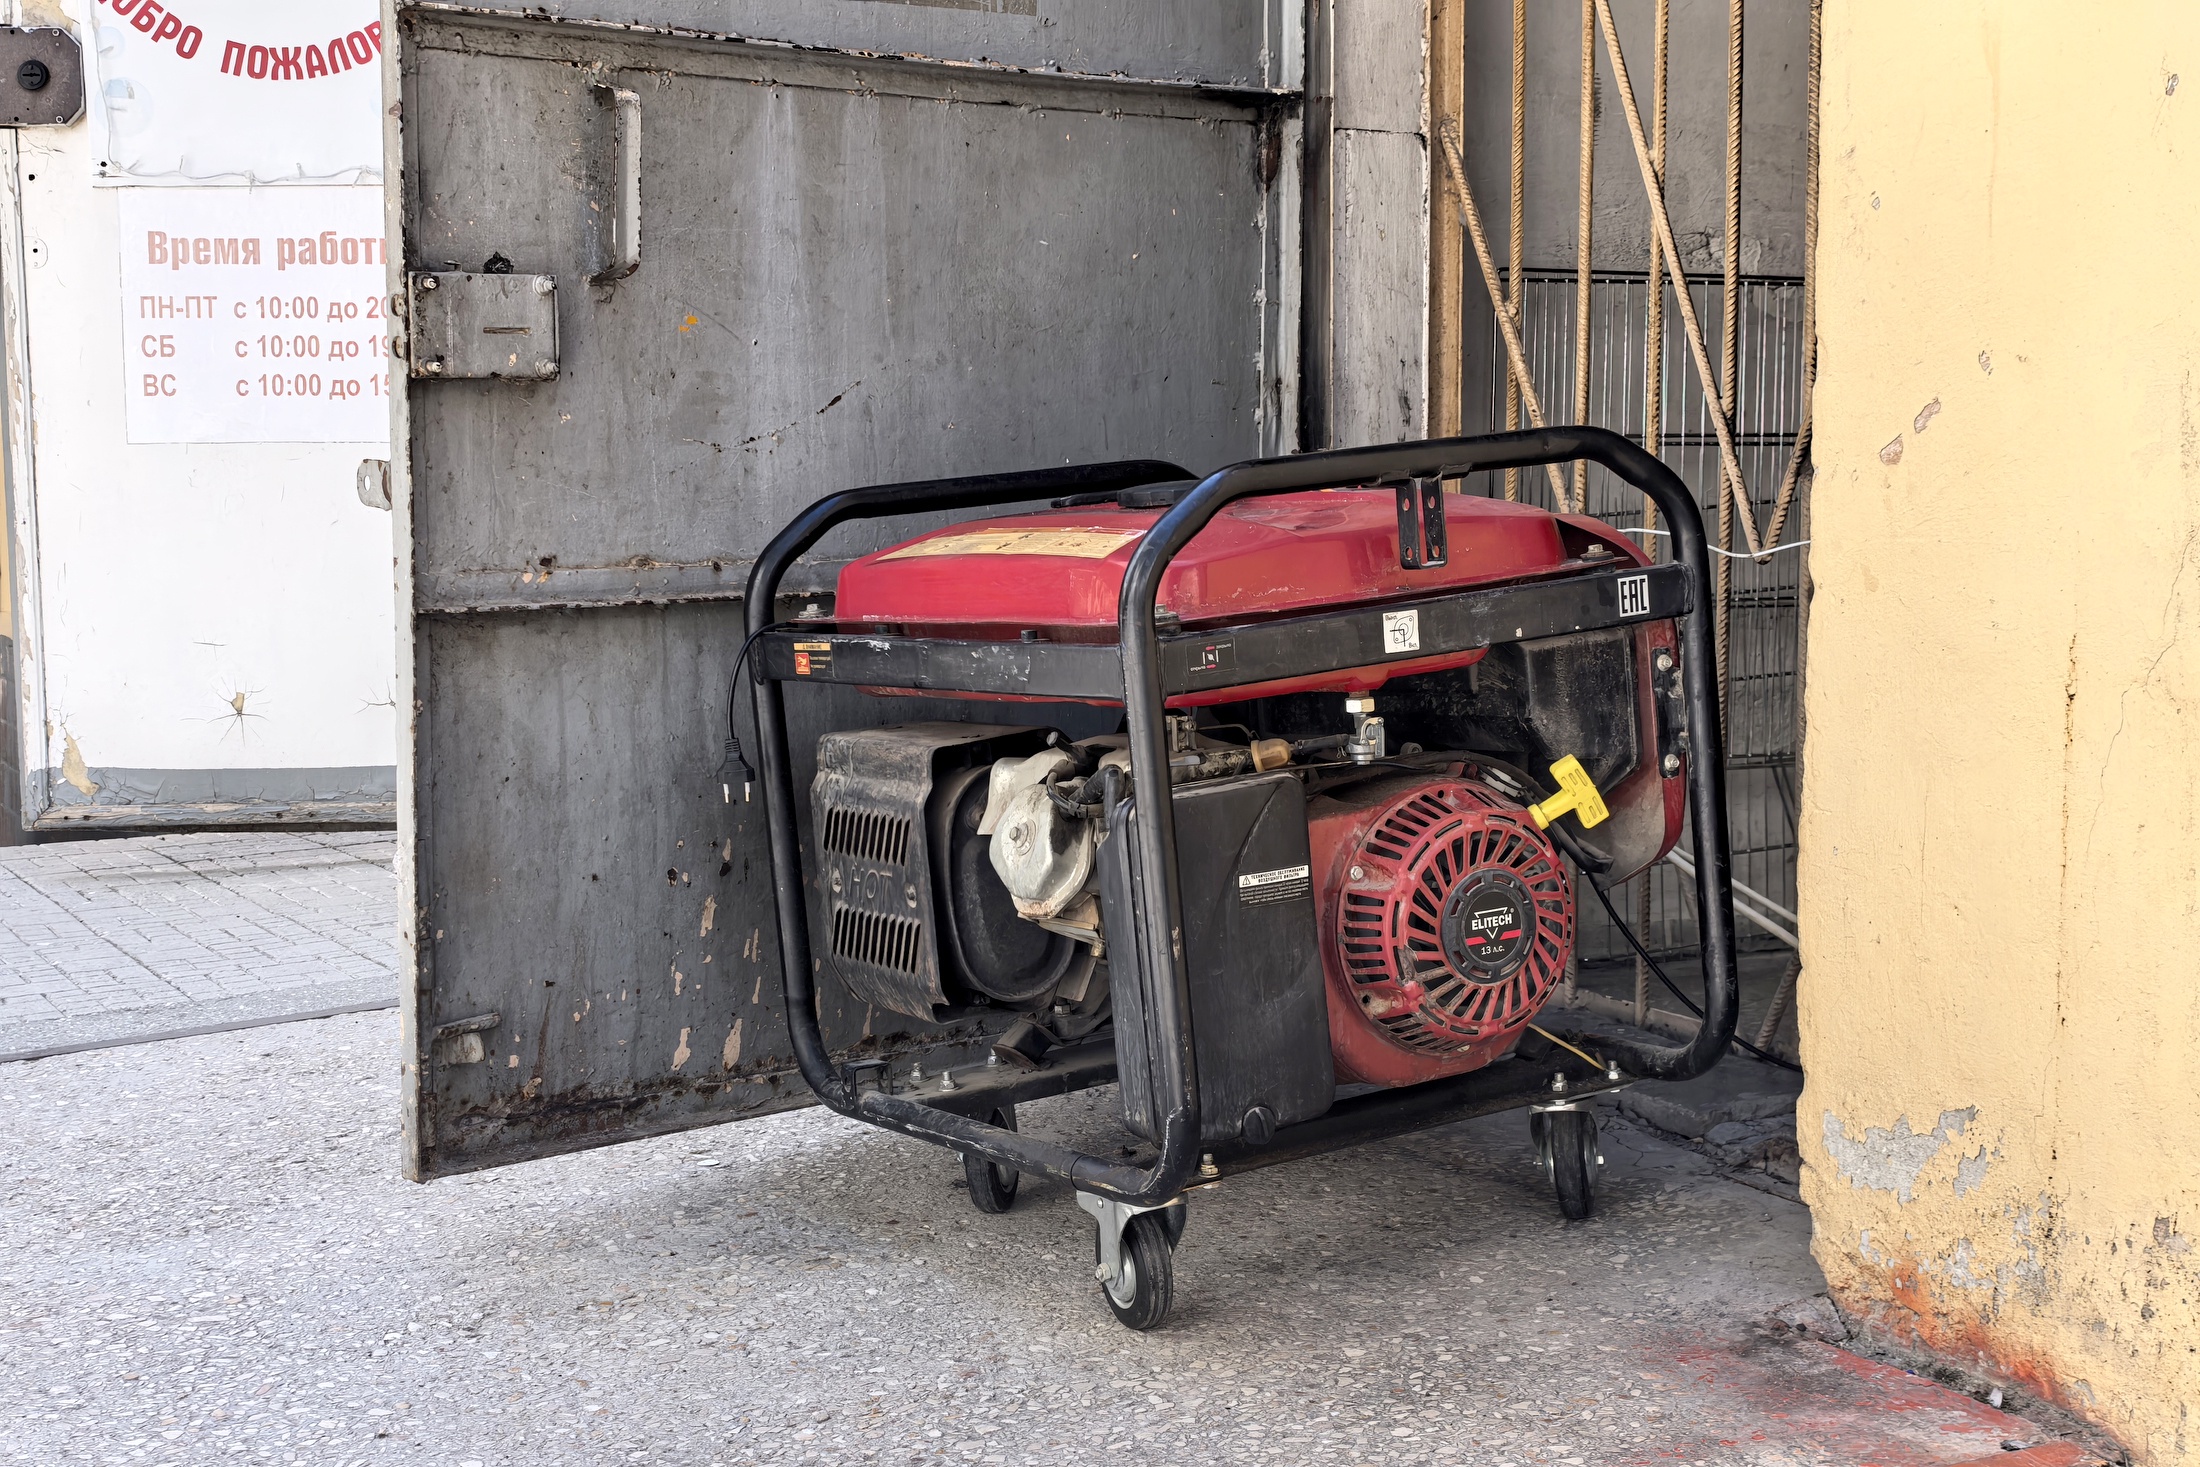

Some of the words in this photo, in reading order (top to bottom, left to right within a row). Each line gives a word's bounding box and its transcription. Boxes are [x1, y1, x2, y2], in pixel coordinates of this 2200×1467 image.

[98, 0, 203, 59] ОБРО
[147, 230, 261, 271] Время
[140, 296, 218, 319] ПН-ПТ
[233, 301, 247, 319] с
[256, 296, 319, 319] 10:00
[327, 301, 359, 323] до
[141, 335, 176, 358] СБ
[234, 340, 248, 358] с
[257, 335, 320, 358] 10:00
[328, 340, 359, 361] до
[143, 374, 177, 397] ВС
[235, 379, 249, 397] с
[258, 374, 322, 397] 10:00
[329, 379, 361, 401] до
[1471, 913, 1512, 930] ELITECH
[1481, 946, 1491, 955] 13
